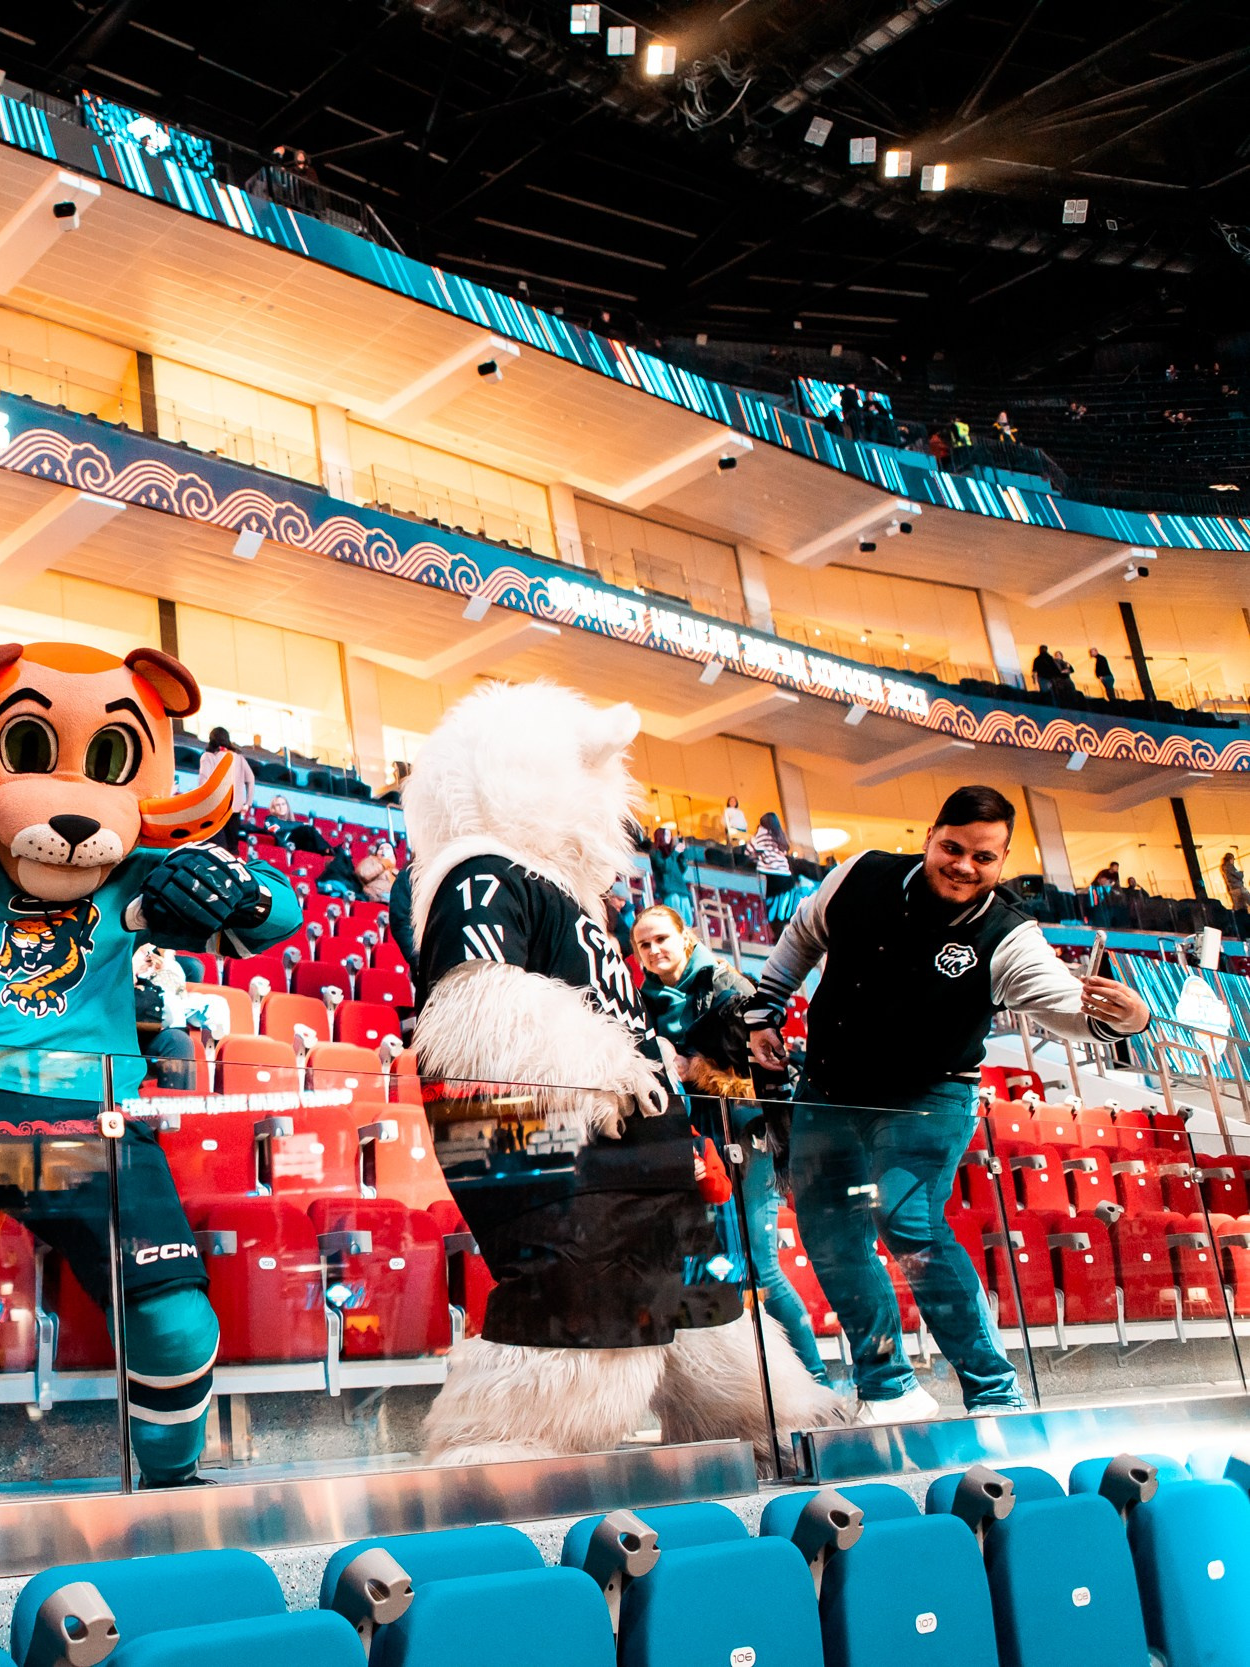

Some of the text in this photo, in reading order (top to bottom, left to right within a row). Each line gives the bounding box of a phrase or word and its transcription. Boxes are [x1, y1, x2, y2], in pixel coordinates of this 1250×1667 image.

[455, 873, 501, 911] 17
[135, 1242, 199, 1266] CCM
[918, 1617, 934, 1628] 107
[732, 1651, 753, 1664] 106
